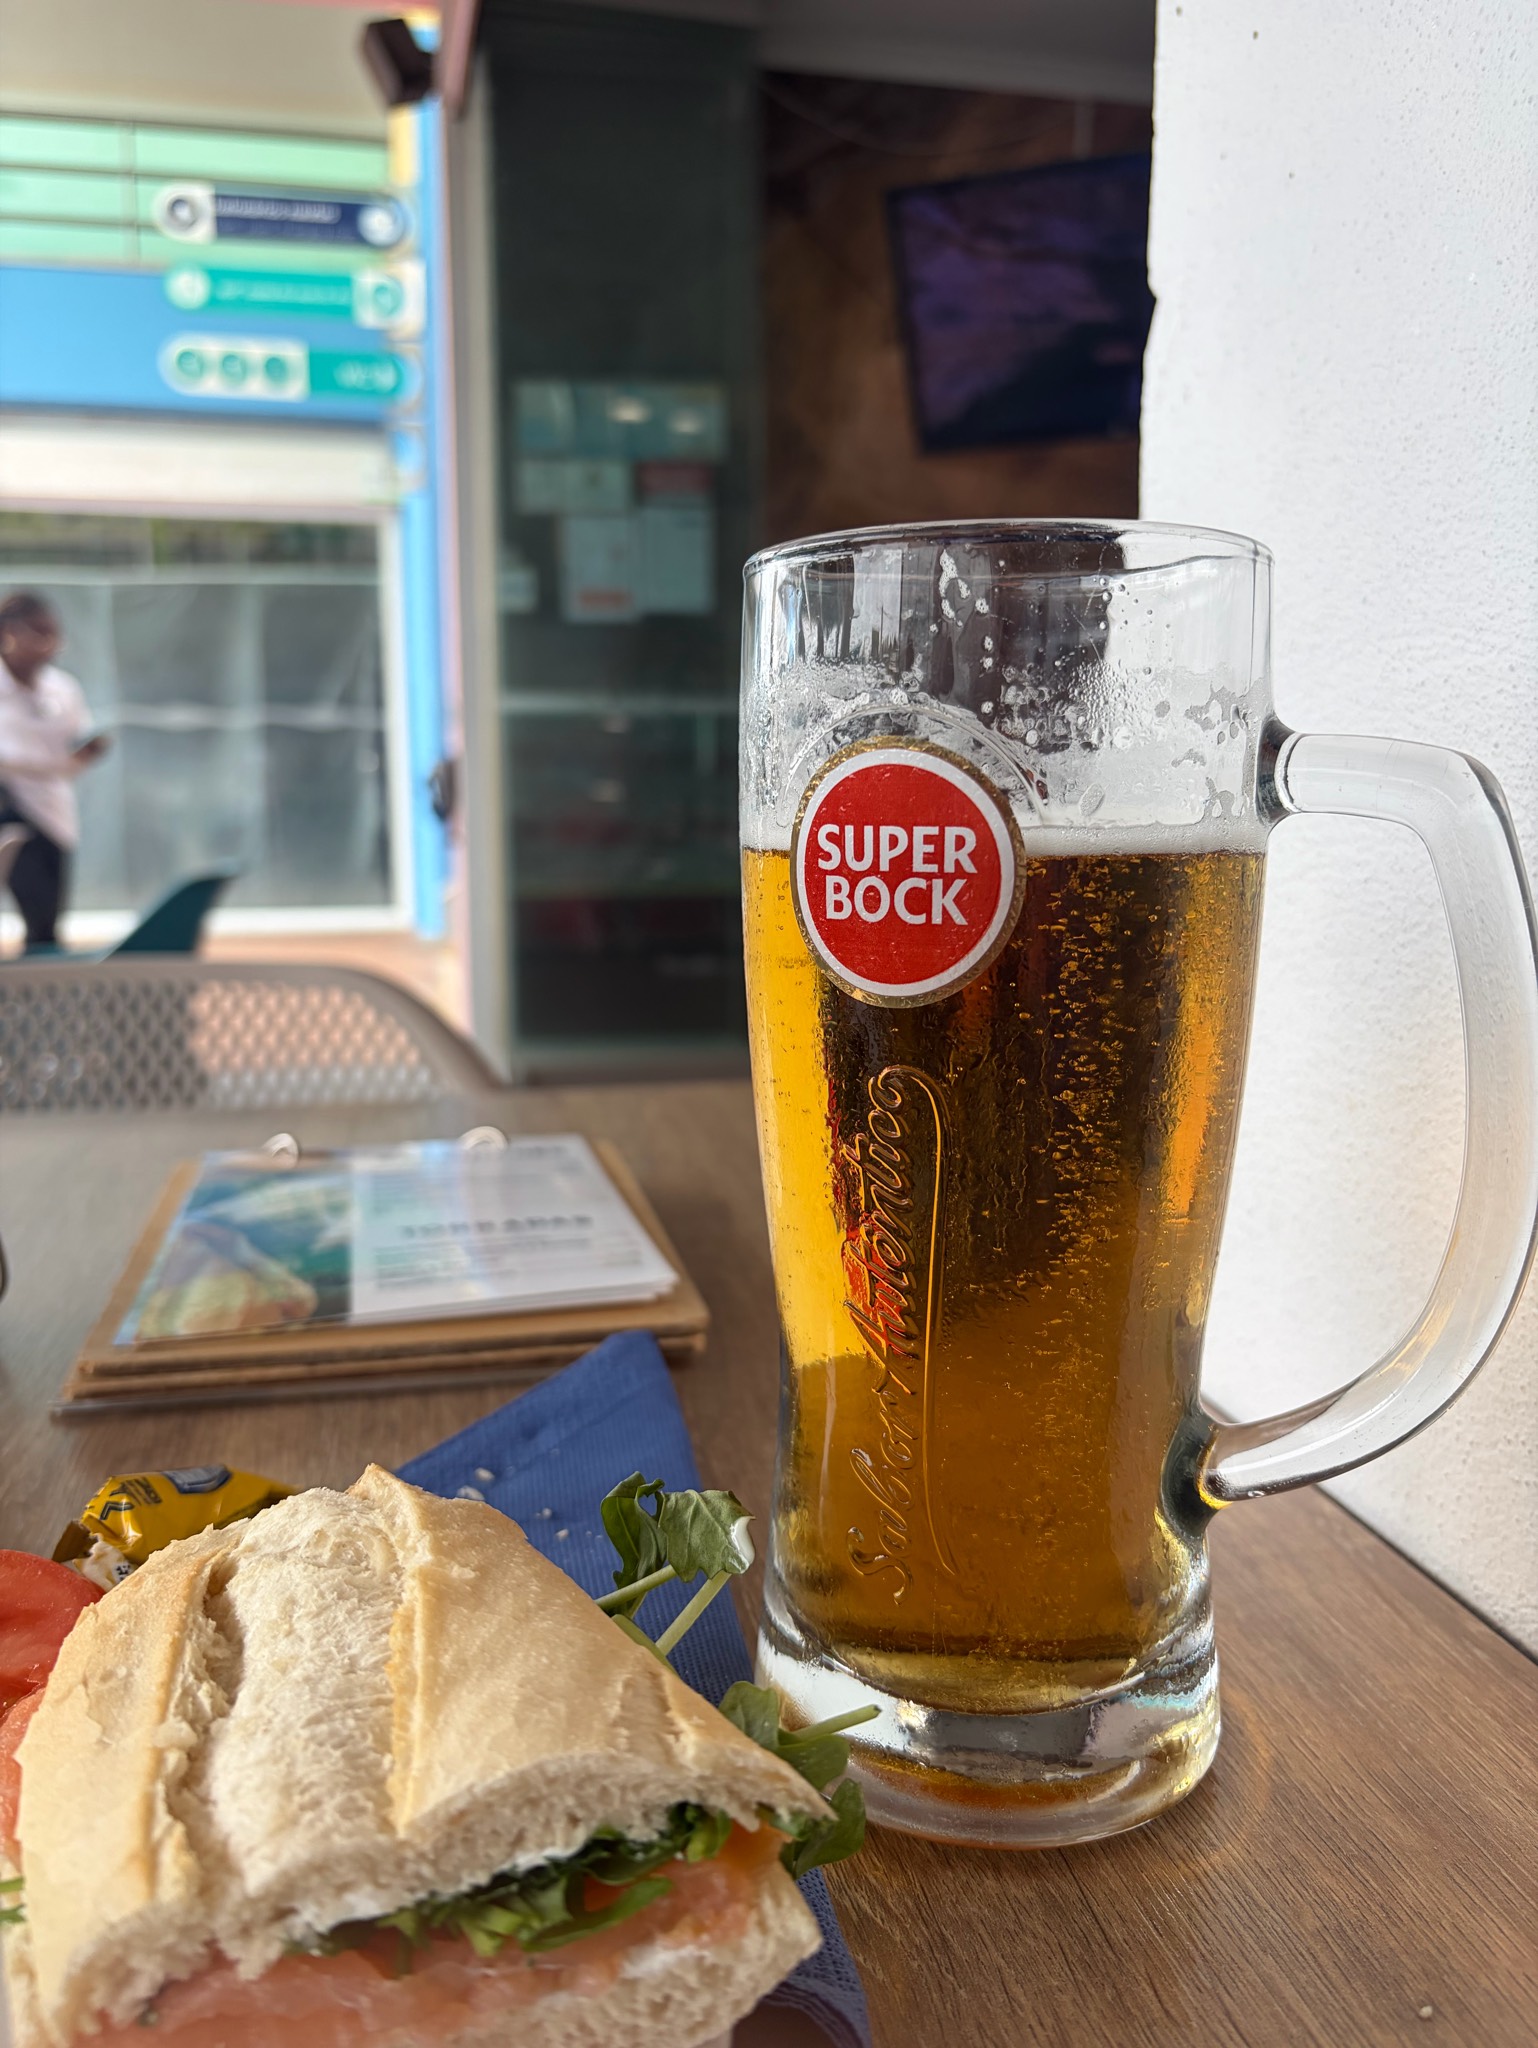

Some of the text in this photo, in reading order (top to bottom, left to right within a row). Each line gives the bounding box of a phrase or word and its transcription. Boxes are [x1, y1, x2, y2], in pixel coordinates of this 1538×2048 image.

[817, 823, 978, 874] SUPER
[825, 875, 969, 926] BOCK
[847, 1390, 919, 1605] Sabor
